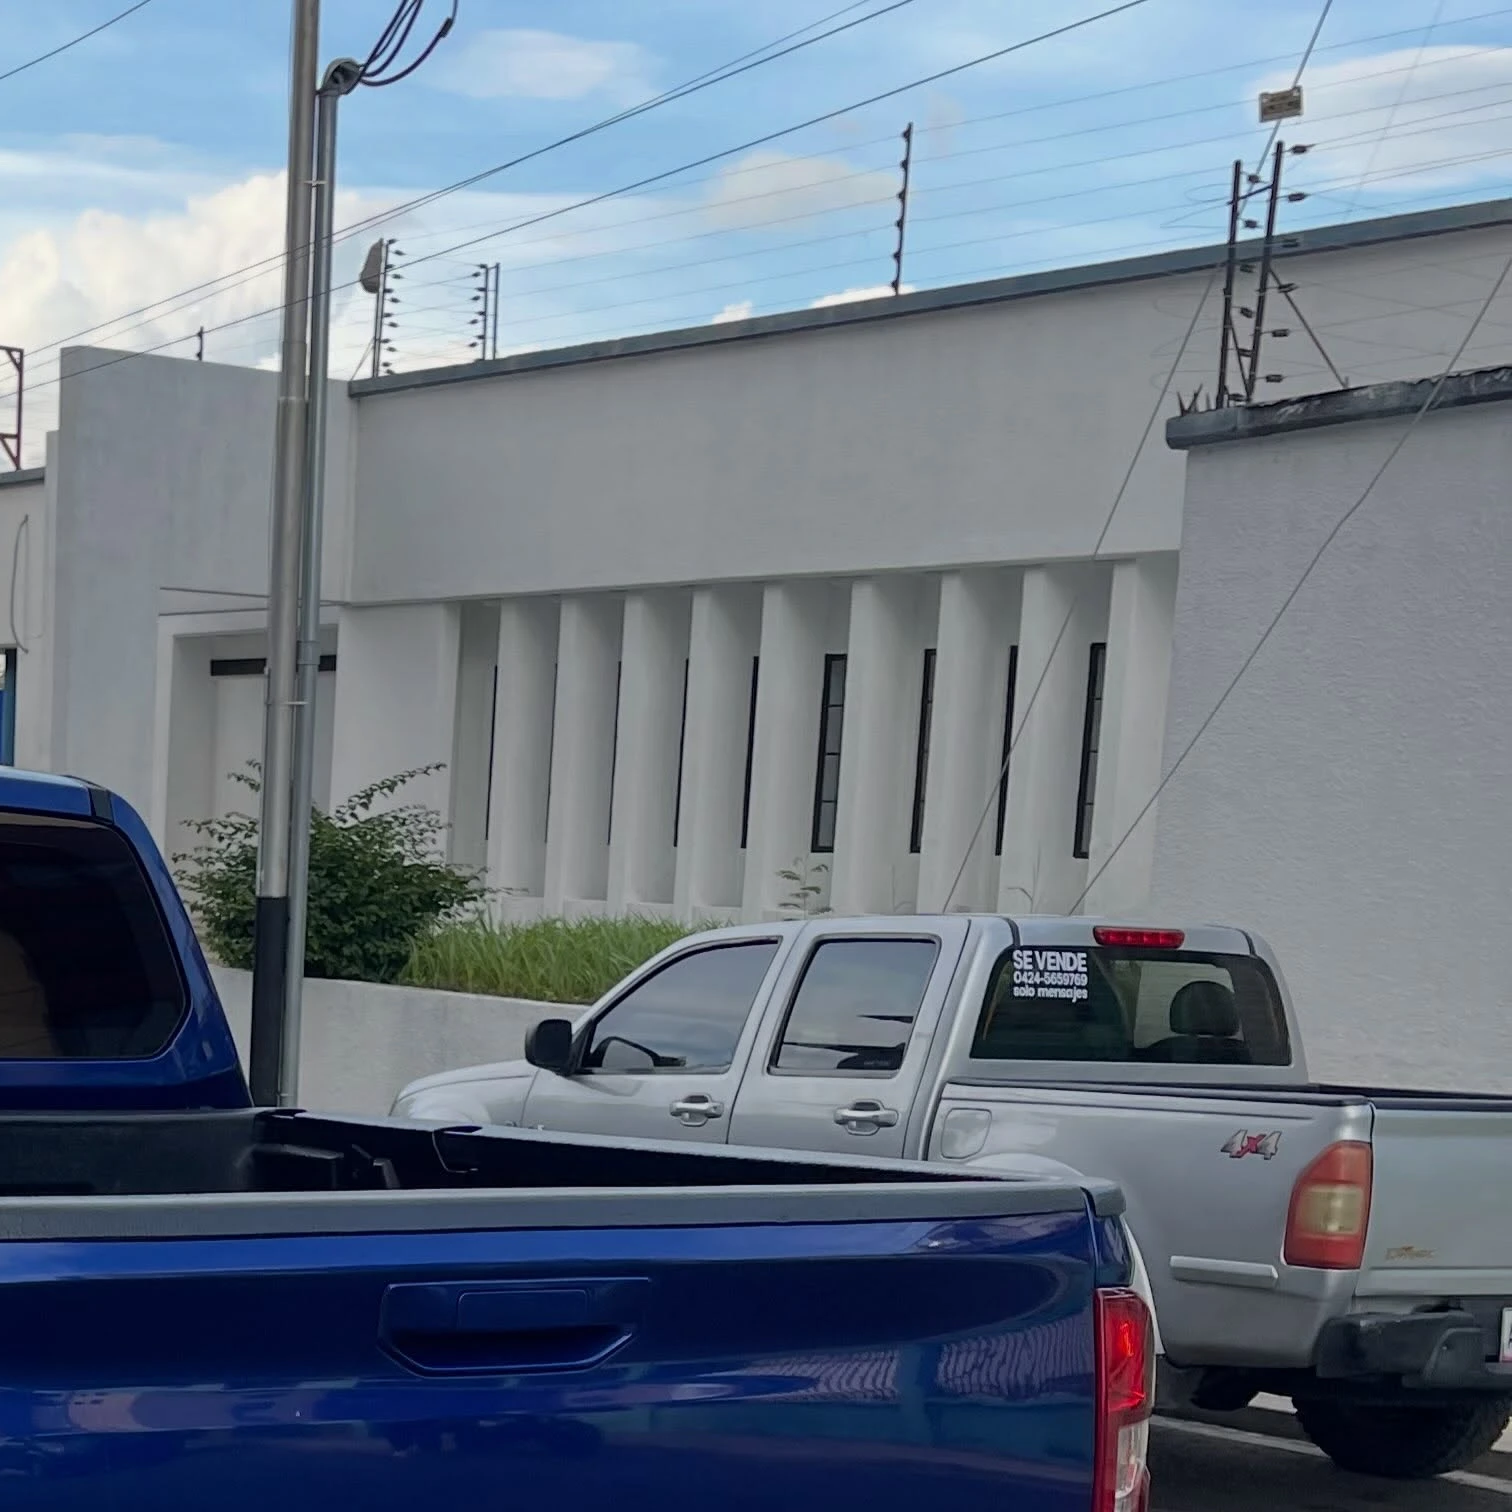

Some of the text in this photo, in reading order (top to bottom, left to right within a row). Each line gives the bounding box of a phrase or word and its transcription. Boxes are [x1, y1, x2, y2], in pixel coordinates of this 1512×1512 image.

[1013, 950, 1088, 972] SE VENDE
[1013, 971, 1088, 986] 0424-5659769
[1013, 985, 1088, 1003] solo mensajes
